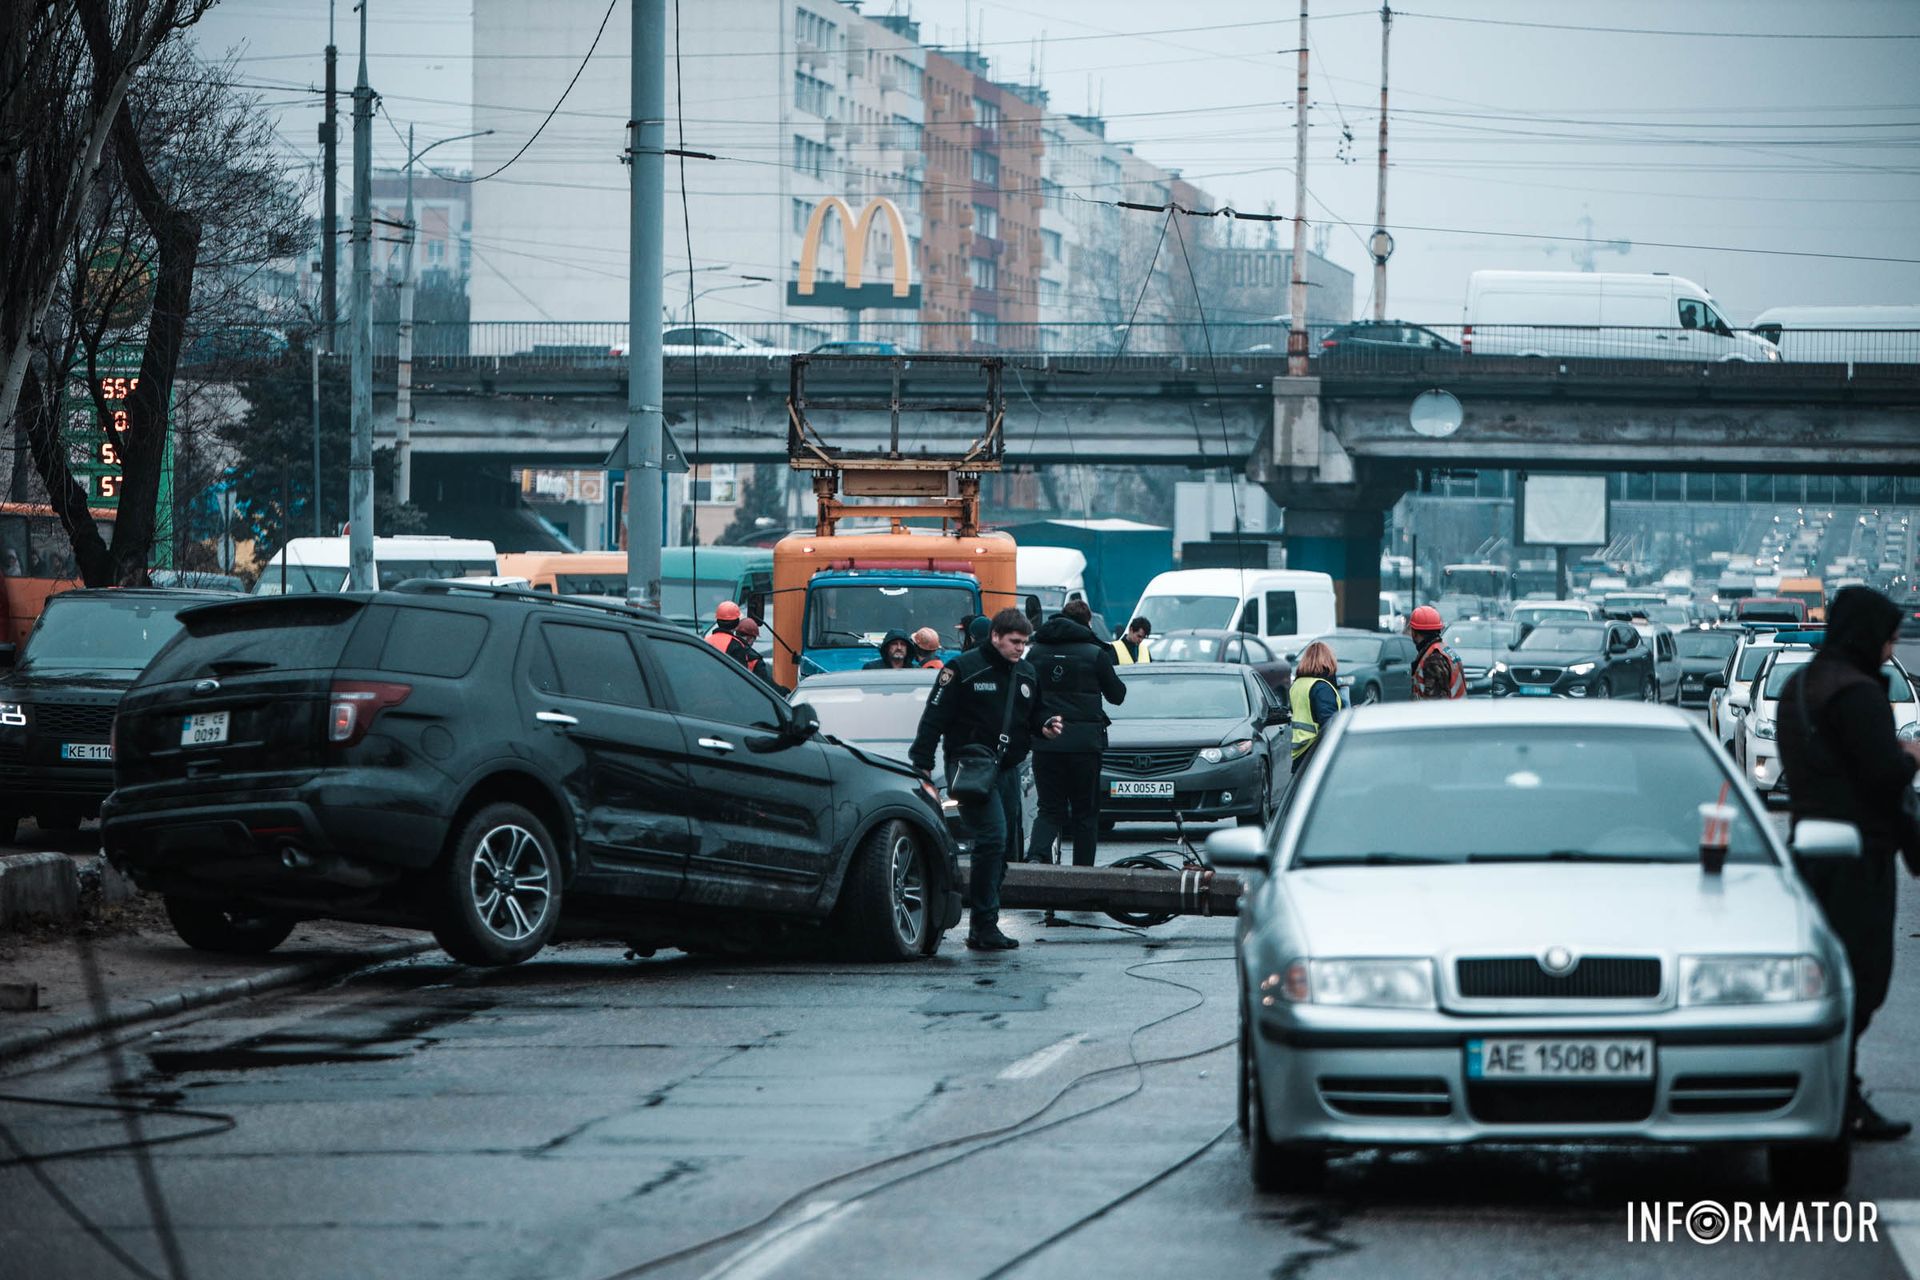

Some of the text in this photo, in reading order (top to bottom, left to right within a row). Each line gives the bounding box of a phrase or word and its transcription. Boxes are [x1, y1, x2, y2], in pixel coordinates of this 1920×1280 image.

[194, 727, 220, 742] 0099
[69, 746, 86, 758] KE
[1117, 783, 1173, 794] AX 0055 AP
[1487, 1043, 1646, 1071] AE 1508 OM
